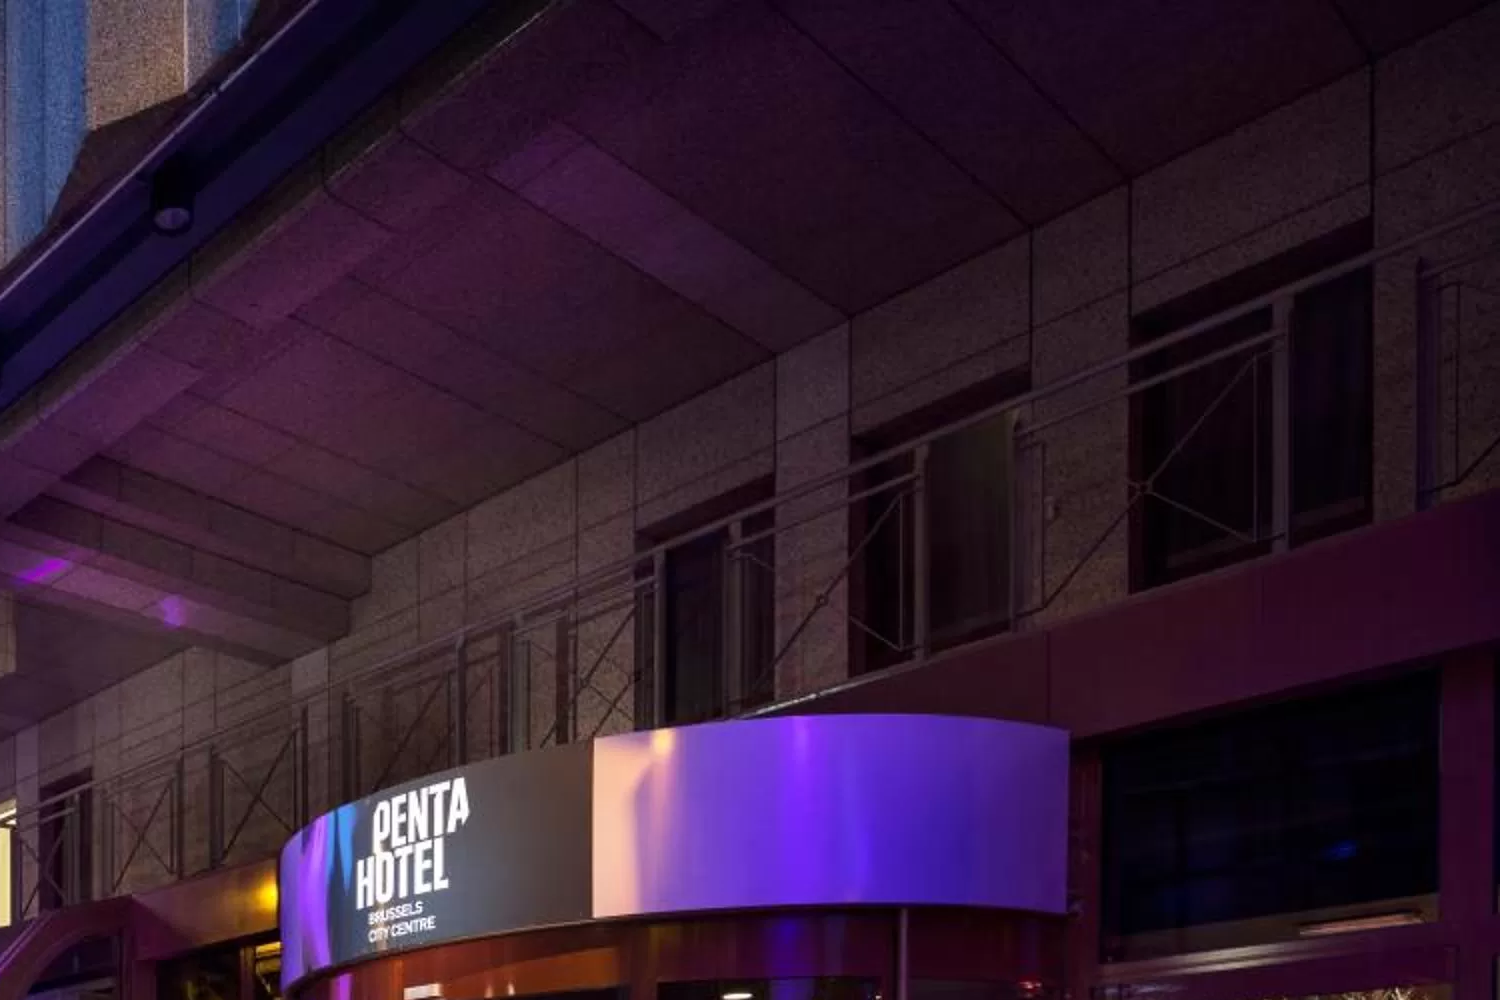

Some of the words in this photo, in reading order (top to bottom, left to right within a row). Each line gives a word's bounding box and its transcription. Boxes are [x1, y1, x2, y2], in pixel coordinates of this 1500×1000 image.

[372, 776, 470, 855] PENTA
[356, 837, 449, 910] HOTEL
[368, 901, 424, 925] BRUSSELS
[368, 927, 388, 943] CITY
[391, 915, 437, 937] CENTRE
